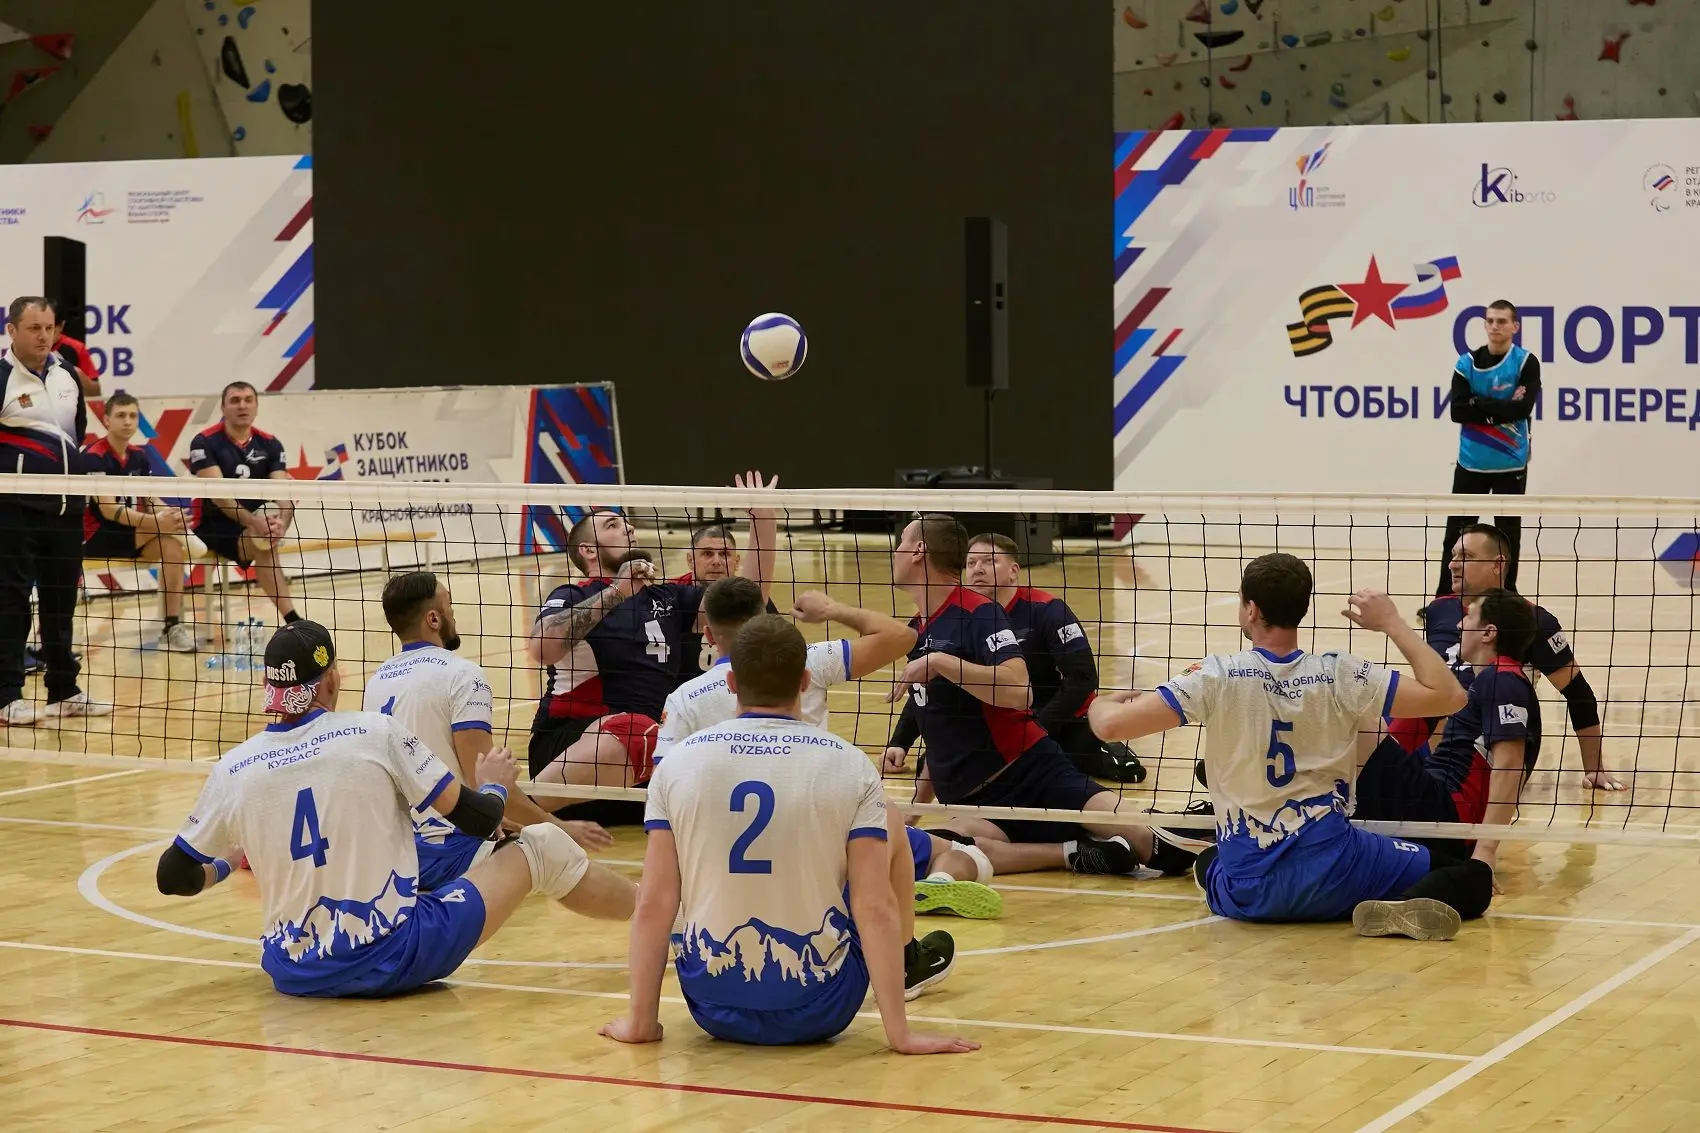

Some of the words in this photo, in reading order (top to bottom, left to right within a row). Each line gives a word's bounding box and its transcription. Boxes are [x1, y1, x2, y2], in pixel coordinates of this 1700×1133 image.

[1685, 177, 1700, 186] ОТ
[1284, 385, 1418, 419] ЧТОБЫ
[353, 431, 408, 451] КУБОК
[357, 453, 469, 478] ЗАЩИТНИКОВ
[645, 620, 670, 663] 4
[688, 679, 727, 700] КЕМЕРО
[229, 742, 308, 776] КЕМЕРОВСКАЯ
[310, 726, 367, 746] ОБЛАСТЬ
[685, 732, 778, 747] КЕМЕРОВСКАЯ
[782, 734, 843, 750] ОБЛАСТЬ
[1266, 719, 1297, 788] 5
[290, 787, 330, 868] 4
[729, 780, 775, 874] 2
